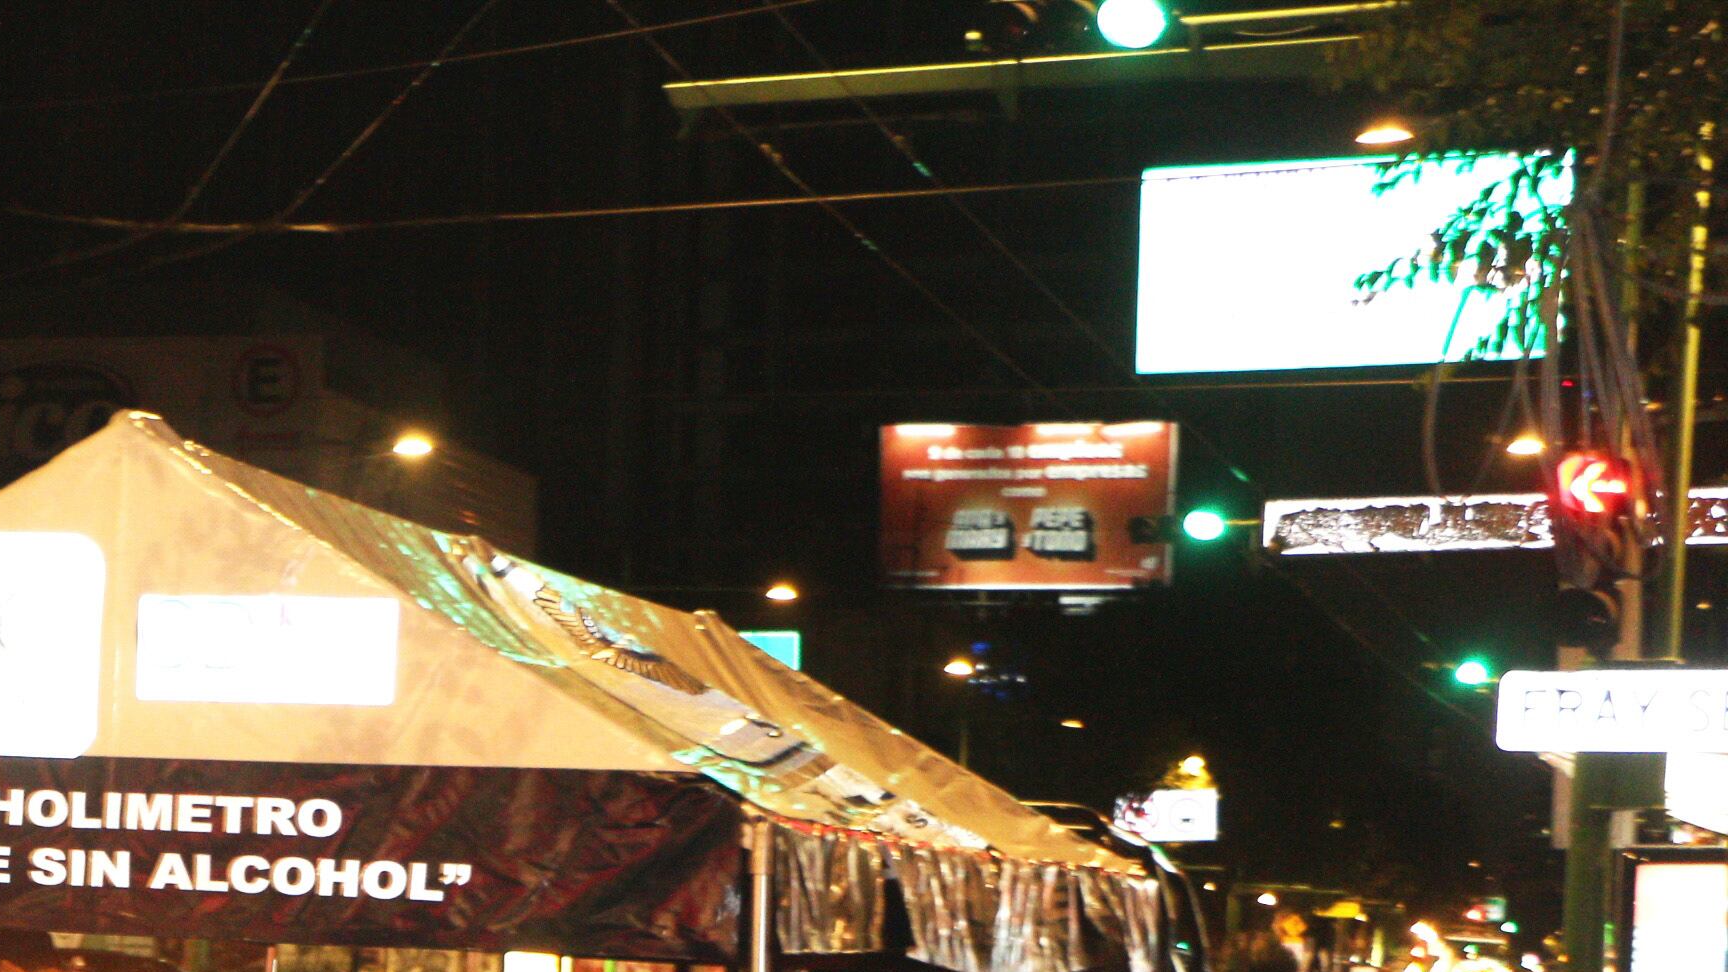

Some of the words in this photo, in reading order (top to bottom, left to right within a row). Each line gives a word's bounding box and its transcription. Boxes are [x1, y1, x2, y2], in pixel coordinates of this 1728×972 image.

[1521, 687, 1660, 729] FRAY
[28, 847, 131, 889] SIN
[147, 852, 472, 902] ALCOHOL”
